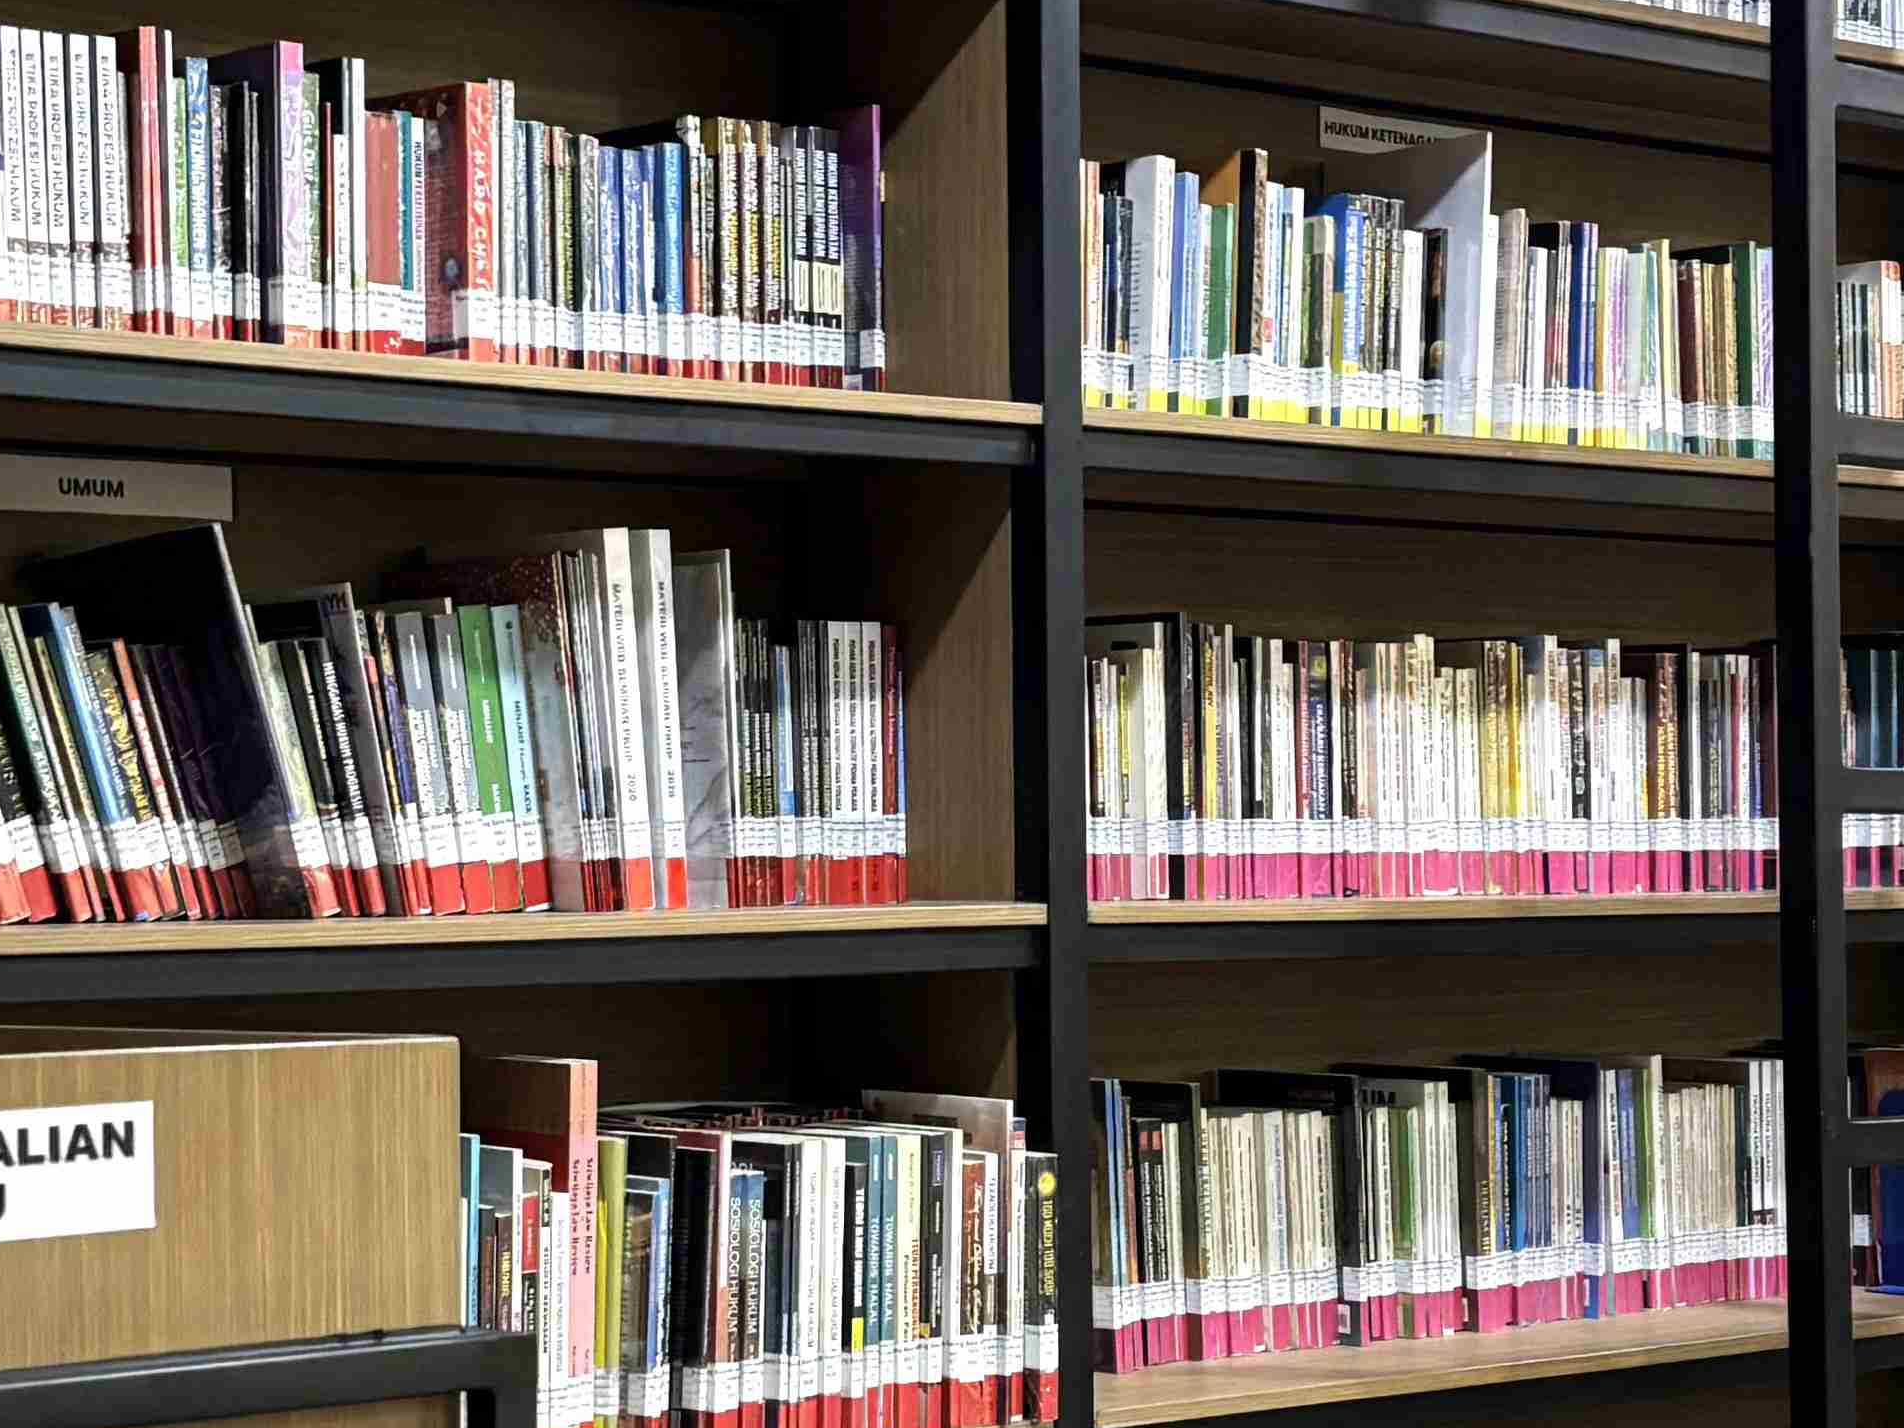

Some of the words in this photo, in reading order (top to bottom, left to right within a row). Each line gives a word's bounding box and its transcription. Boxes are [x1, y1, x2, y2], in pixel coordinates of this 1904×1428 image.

[1323, 120, 1371, 141] HUKUM
[53, 170, 64, 228] HUKUM
[104, 169, 117, 227] HUKUM
[57, 476, 125, 499] UMUM
[612, 583, 626, 631] MATERI
[571, 1237, 580, 1276] Review
[585, 1235, 594, 1275] Review
[728, 1196, 742, 1277] SOSIOLOGI
[747, 1198, 763, 1278] SOSIOLOGI
[884, 1216, 896, 1277] TOWARDS
[727, 1281, 739, 1333] HUKUM
[747, 1281, 760, 1335] HUKUM
[884, 1282, 895, 1324] HALAL
